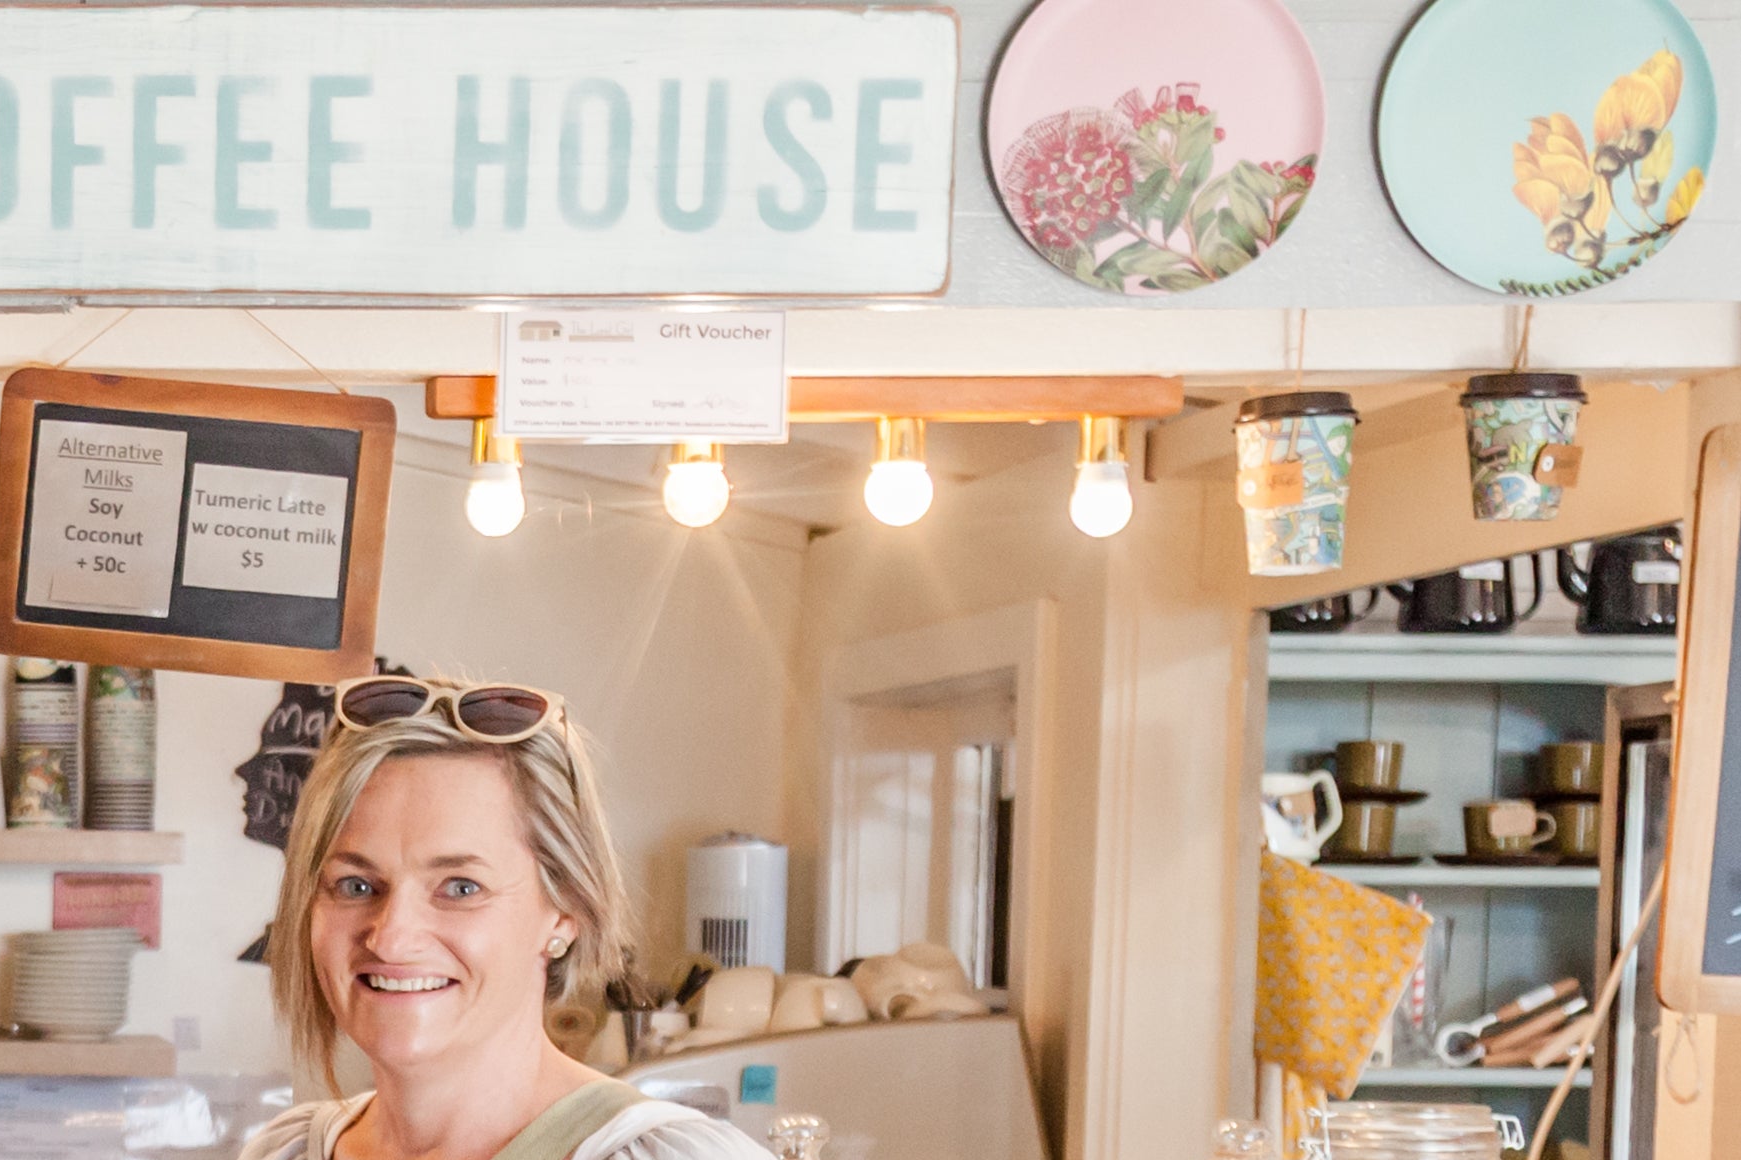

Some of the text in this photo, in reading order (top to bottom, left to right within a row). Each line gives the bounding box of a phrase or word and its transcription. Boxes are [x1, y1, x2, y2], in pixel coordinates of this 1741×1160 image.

[453, 75, 923, 232] HOUSE
[660, 323, 692, 339] Gift
[697, 324, 773, 341] Voucher
[58, 437, 164, 464] Alternative
[83, 468, 134, 490] Milks
[89, 497, 124, 519] Soy
[195, 489, 327, 516] Tumeric Latte
[64, 524, 144, 547] Coconut
[192, 520, 338, 546] w coconut milk
[77, 555, 127, 574] + 50c
[241, 550, 264, 569] $5
